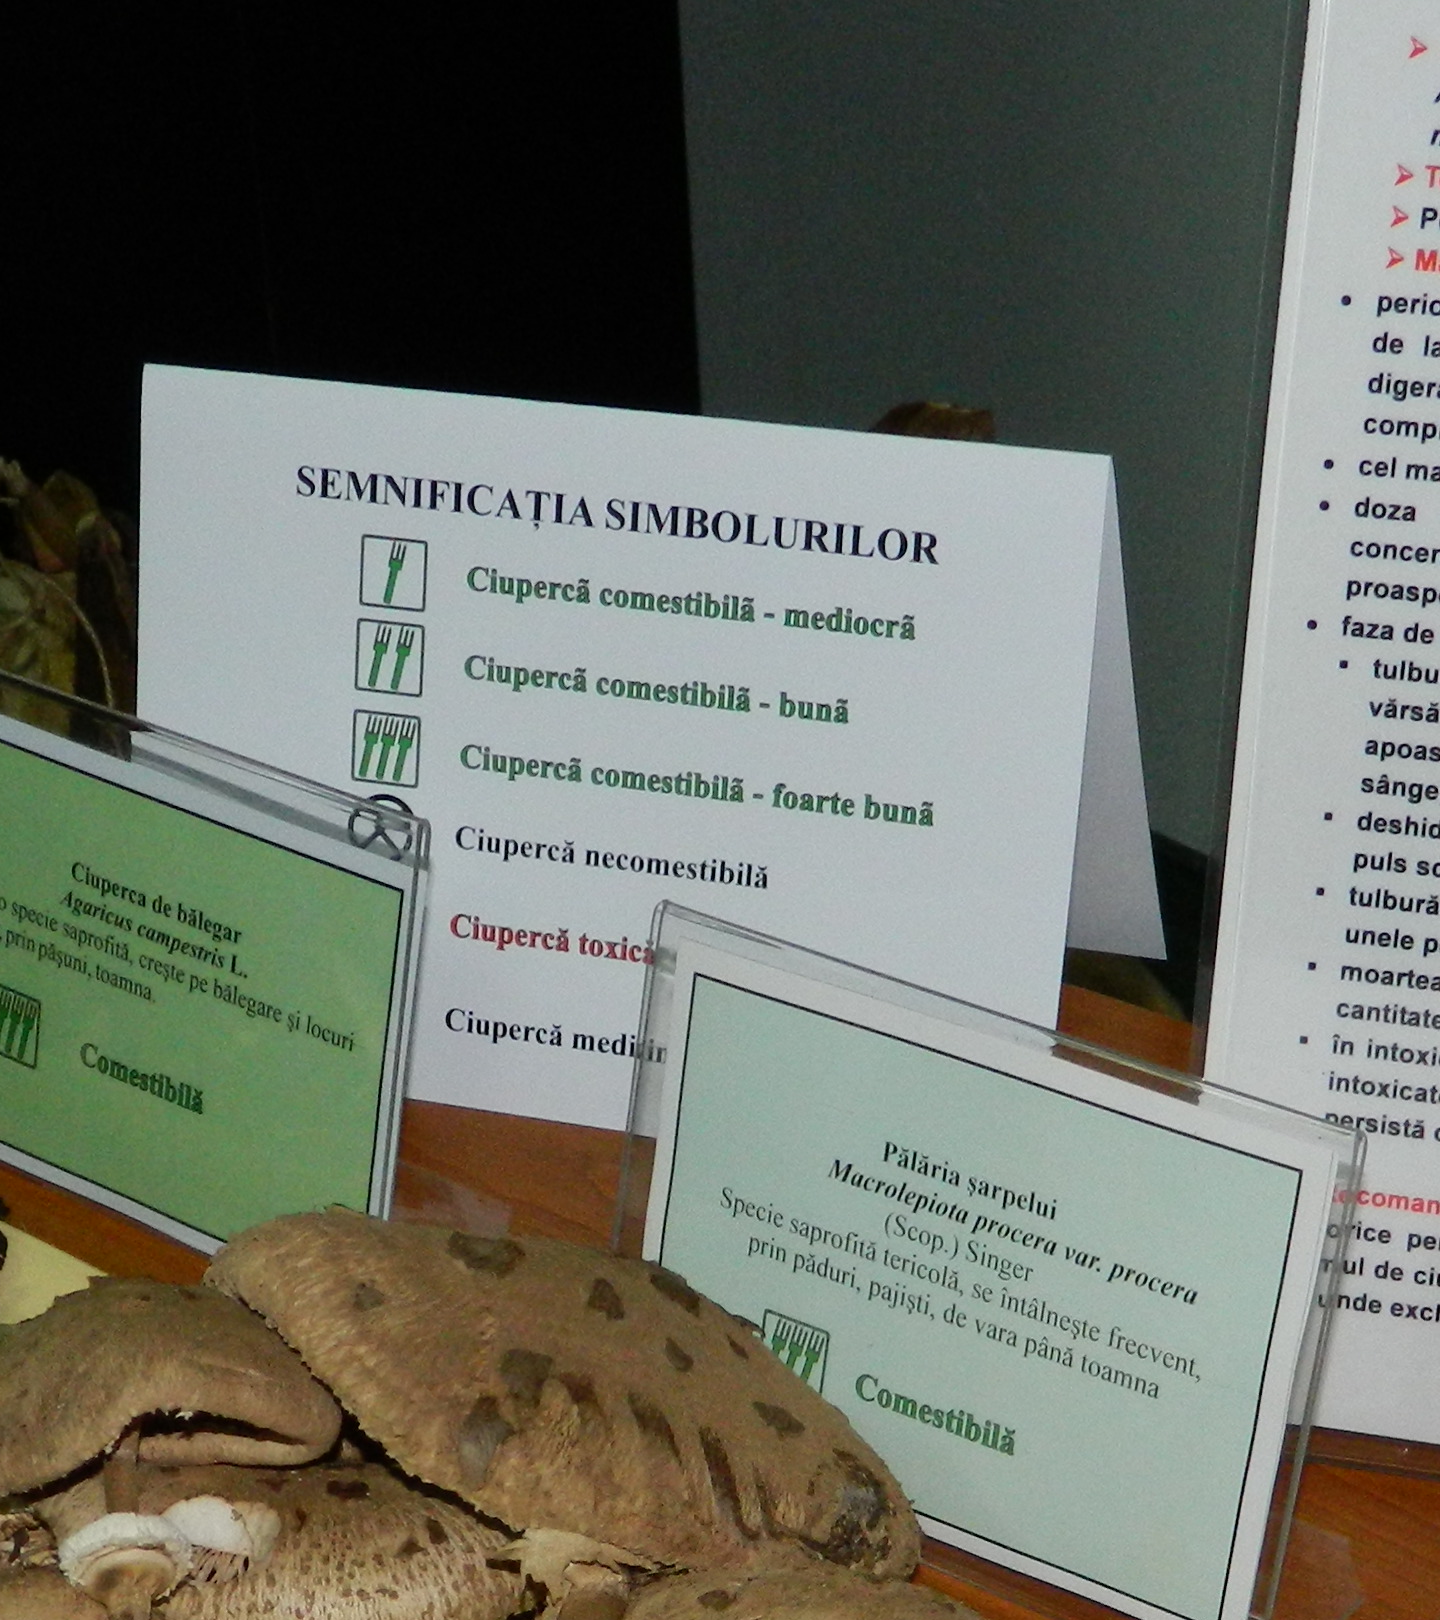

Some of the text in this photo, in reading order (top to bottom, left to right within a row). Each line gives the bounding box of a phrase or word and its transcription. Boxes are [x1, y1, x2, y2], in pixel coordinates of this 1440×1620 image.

[604, 497, 940, 566] SIMBOLURILOR
[770, 781, 856, 818] foarte
[454, 824, 769, 891] Ciupercă necomestibilă
[62, 889, 134, 933] Agaricus
[135, 923, 226, 969] campestris
[70, 860, 244, 945] Ciuperca de bălegar
[448, 912, 571, 954] Ciupercă
[10, 900, 59, 933] specie
[187, 973, 210, 995] pe
[212, 976, 284, 1025] bălegare
[304, 1013, 356, 1054] locuri
[444, 1007, 563, 1047] Ciupercă
[79, 1041, 205, 1117] Comestibilă
[882, 1140, 961, 1188] Pălăria
[827, 1157, 1199, 1306] Macrolepiota procera var. procera
[883, 1212, 1035, 1283] (Scop.) Singer
[719, 1186, 785, 1229] Specie
[788, 1217, 878, 1263] saprofită
[882, 1247, 965, 1298] tericolă,
[971, 1282, 995, 1304] se
[1107, 1325, 1202, 1383] frecvent,
[746, 1235, 788, 1264] prin
[791, 1252, 862, 1294] păduri,
[941, 1302, 968, 1330] de
[974, 1317, 1019, 1349] vara
[1022, 1335, 1075, 1369] până
[1079, 1354, 1161, 1401] toamna
[853, 1372, 1017, 1458] Comestibilă
